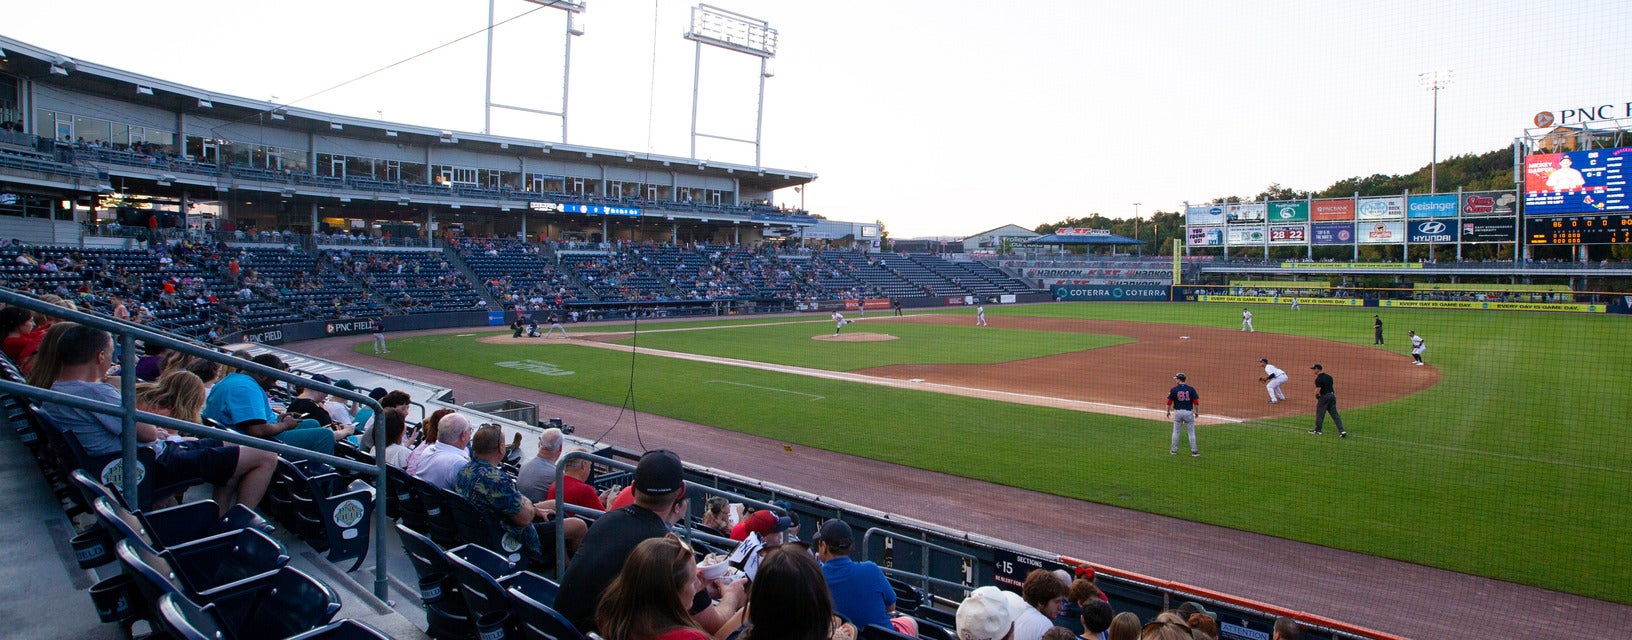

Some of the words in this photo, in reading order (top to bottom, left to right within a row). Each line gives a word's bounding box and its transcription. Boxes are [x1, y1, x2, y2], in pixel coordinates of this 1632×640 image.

[1561, 104, 1614, 124] PNC
[1410, 202, 1455, 211] Geisinger
[1272, 231, 1285, 239] 28
[1289, 231, 1303, 239] 22
[1070, 289, 1110, 297] COTERRA
[1125, 289, 1166, 297] COTERRA
[335, 322, 352, 332] PNC
[250, 333, 264, 343] PNC
[264, 330, 282, 341] FIELD
[339, 505, 355, 514] PNC
[1017, 555, 1043, 568] SECTIONS
[1002, 560, 1013, 574] 15
[1001, 576, 1013, 584] ALERT
[1222, 624, 1267, 640] ATTENTION
